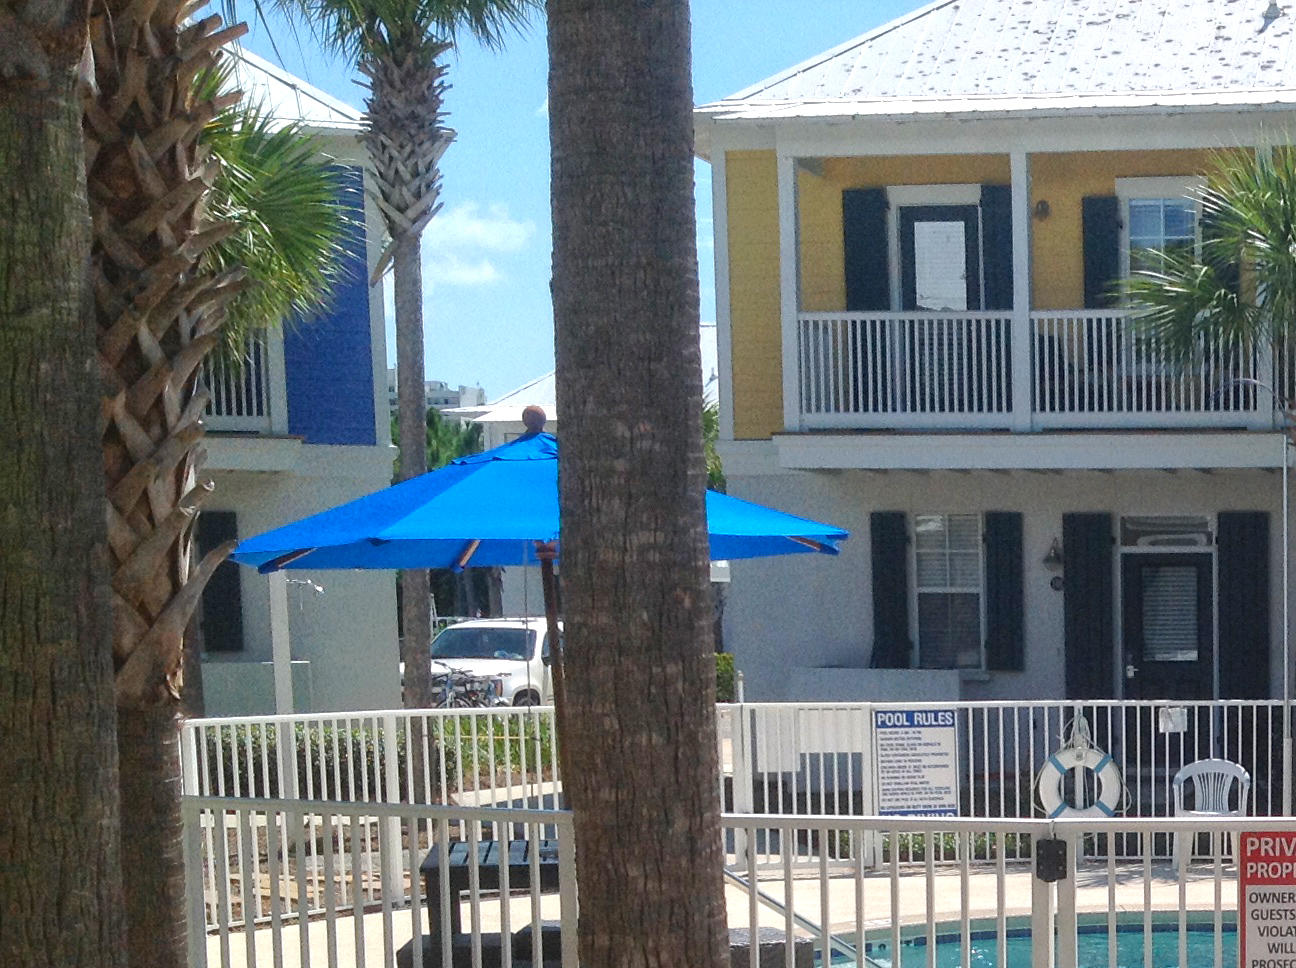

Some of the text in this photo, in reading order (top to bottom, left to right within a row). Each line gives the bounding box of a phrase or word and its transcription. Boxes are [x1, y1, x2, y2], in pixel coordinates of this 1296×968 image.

[877, 711, 953, 726] POOL RULES
[1251, 909, 1296, 920] GUESTS
[1267, 943, 1296, 954] WILL
